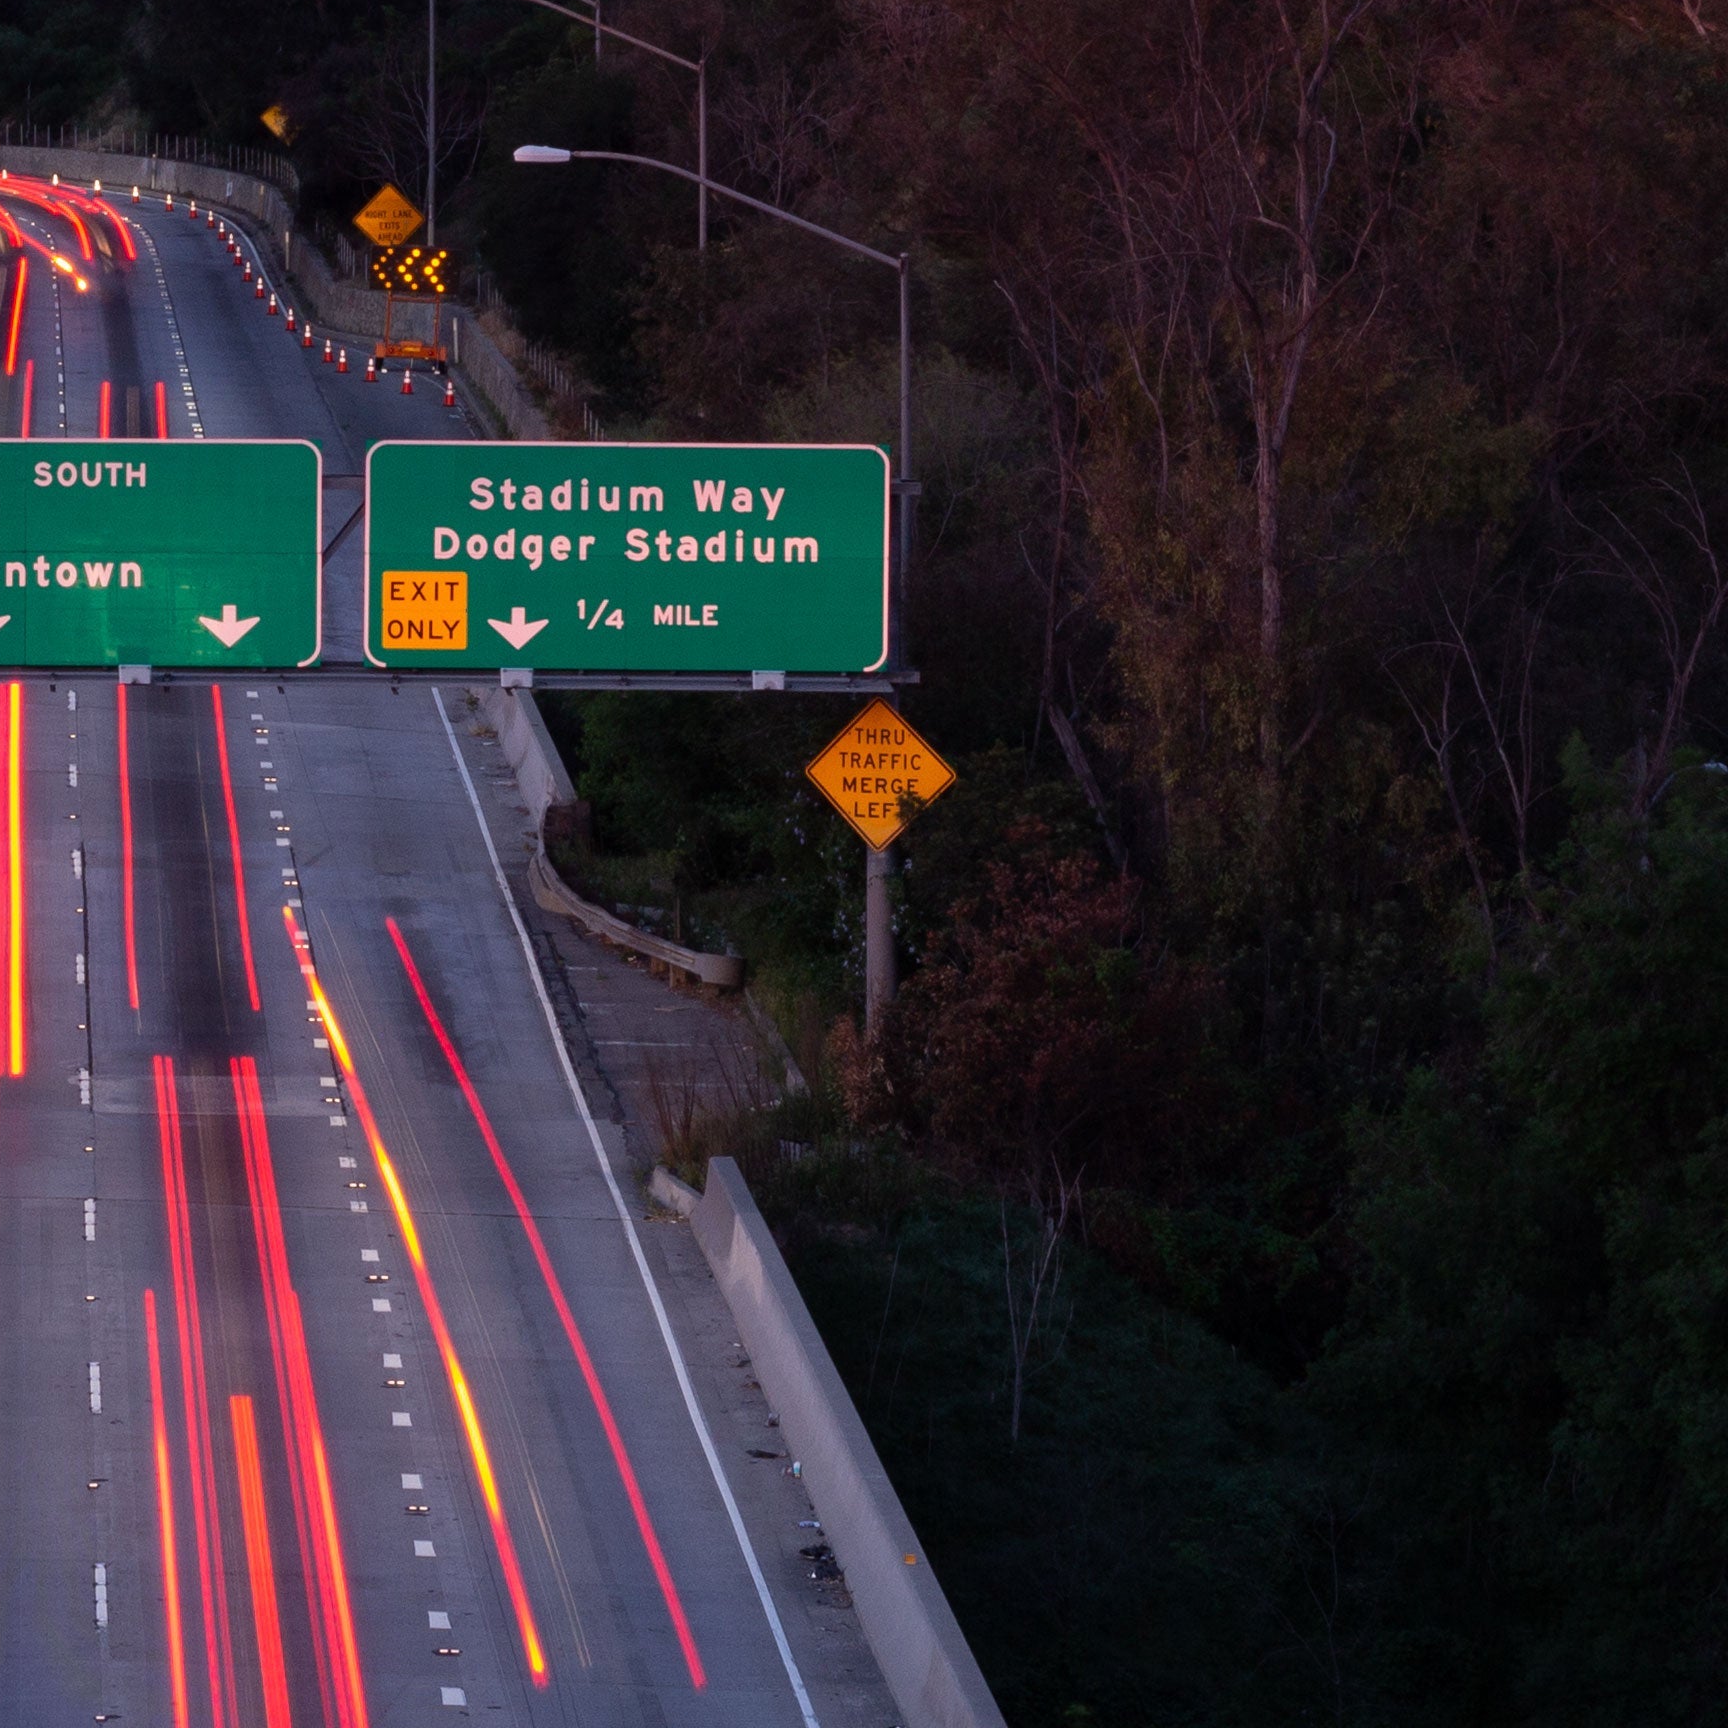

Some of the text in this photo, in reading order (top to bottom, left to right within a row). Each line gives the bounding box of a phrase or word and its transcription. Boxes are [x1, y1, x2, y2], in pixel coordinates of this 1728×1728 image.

[34, 462, 147, 488] SOUTH
[470, 478, 785, 521] Stadium Way
[434, 527, 819, 571] Dodger Stadium
[390, 581, 459, 602] EXIT
[576, 598, 719, 630] 1/4 MILE
[387, 619, 460, 640] ONLY
[855, 727, 906, 746] THRU
[839, 751, 921, 771] TRAFFIC
[842, 776, 919, 795] MERGE
[854, 801, 904, 819] LEF
